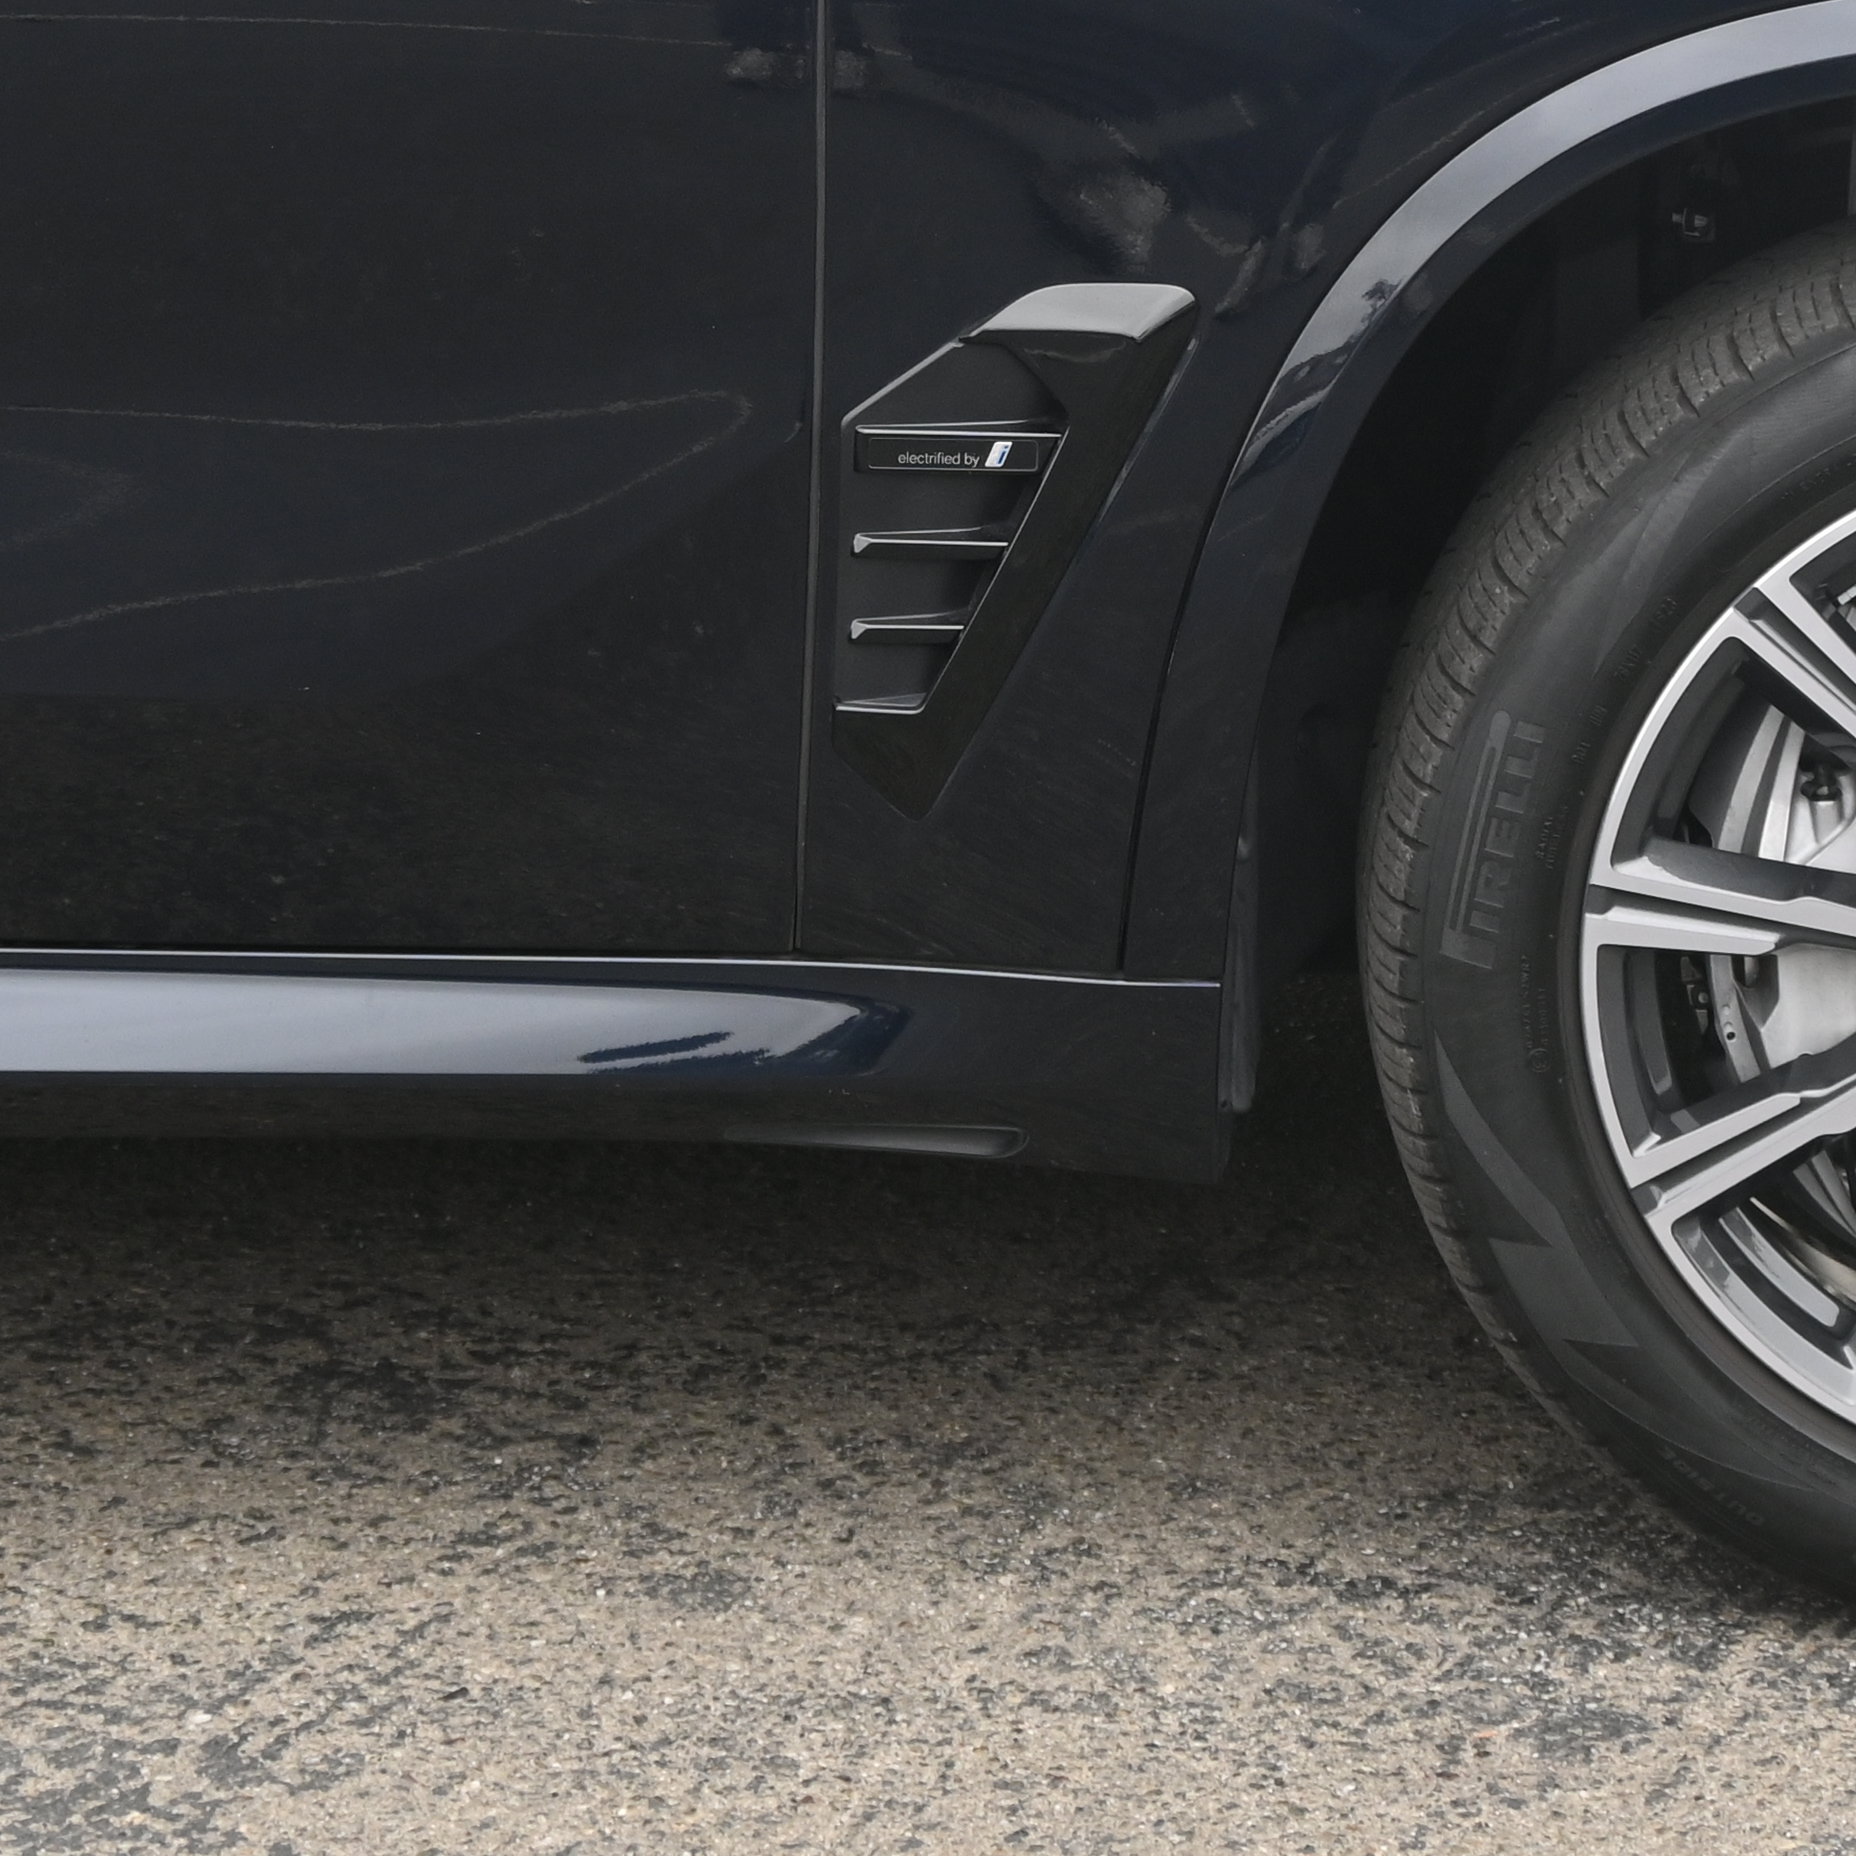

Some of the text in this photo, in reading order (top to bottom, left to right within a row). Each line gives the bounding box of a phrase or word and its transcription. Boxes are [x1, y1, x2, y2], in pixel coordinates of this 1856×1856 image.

[897, 450, 960, 465] electrified
[963, 452, 980, 468] by
[1440, 709, 1546, 971] PIRELLI
